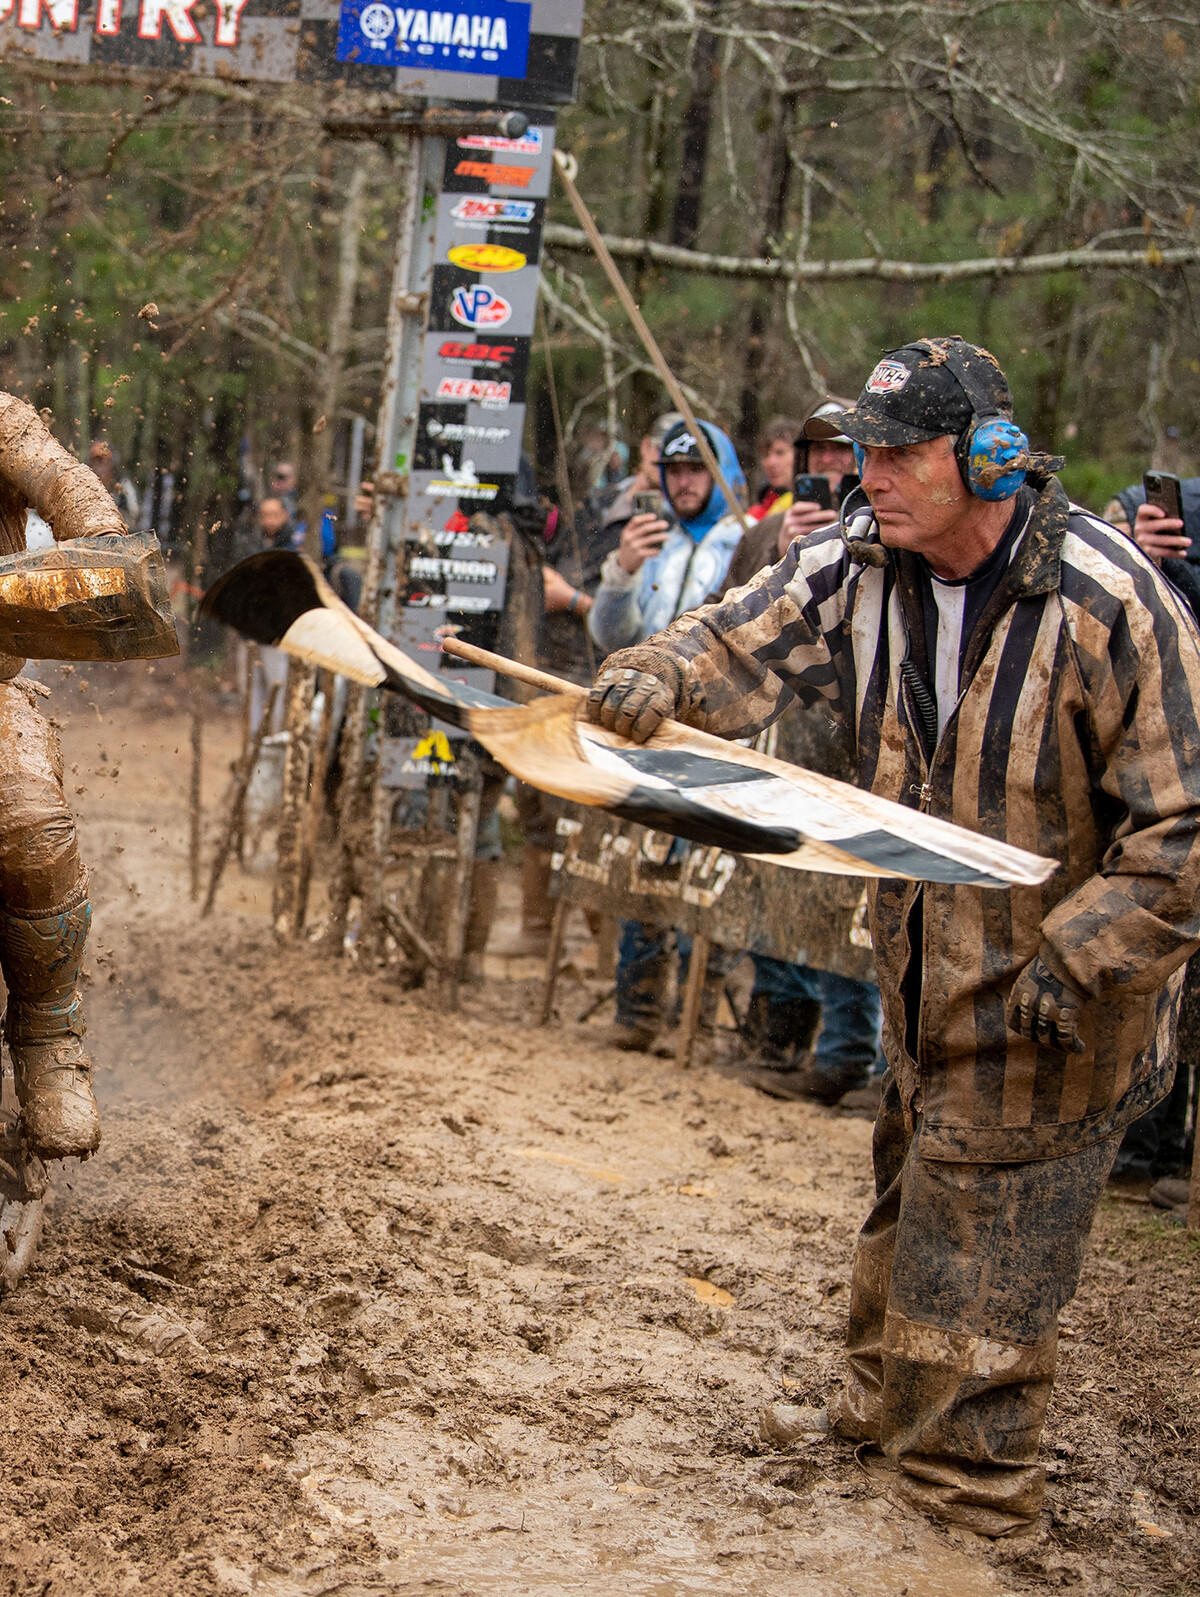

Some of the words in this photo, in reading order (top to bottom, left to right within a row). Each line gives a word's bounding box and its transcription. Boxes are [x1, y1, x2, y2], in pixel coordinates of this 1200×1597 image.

[395, 7, 508, 50] YAMAHA
[459, 200, 530, 218] AMSOIL
[458, 289, 492, 322] VP
[439, 341, 516, 362] GBC
[439, 380, 510, 399] KENDA
[410, 556, 497, 577] METHOD
